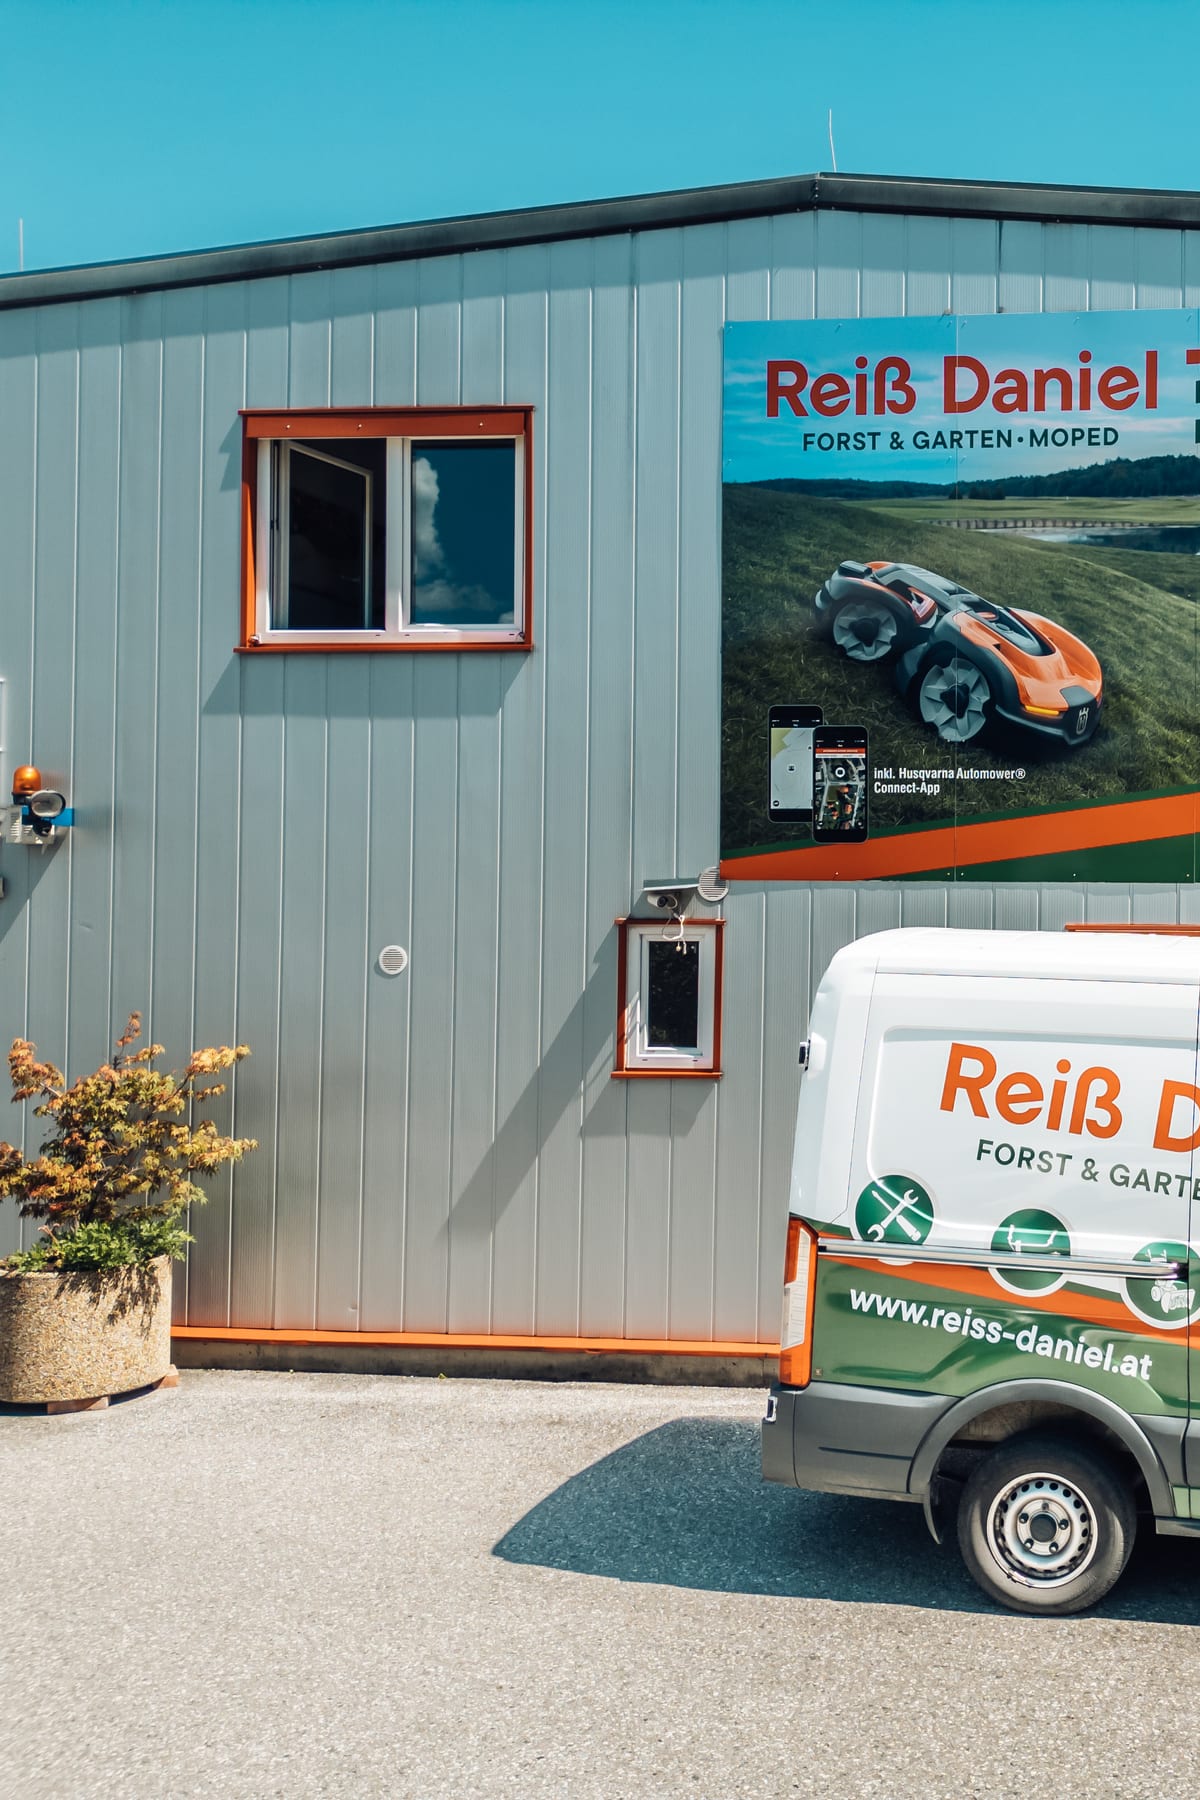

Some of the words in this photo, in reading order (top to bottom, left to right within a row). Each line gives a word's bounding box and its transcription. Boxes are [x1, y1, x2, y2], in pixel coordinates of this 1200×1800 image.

[766, 356, 916, 417] Reiß
[943, 350, 1158, 413] Daniel
[803, 431, 881, 451] FORST
[890, 429, 904, 450] &
[874, 767, 895, 780] inkl.
[899, 767, 954, 780] Husqvarna
[874, 782, 940, 795] Connect-App
[939, 1043, 1122, 1139] Reiß
[976, 1139, 1072, 1177] FORST
[1080, 1158, 1098, 1182] &
[850, 1289, 1152, 1381] www.reiss-daniel.at
